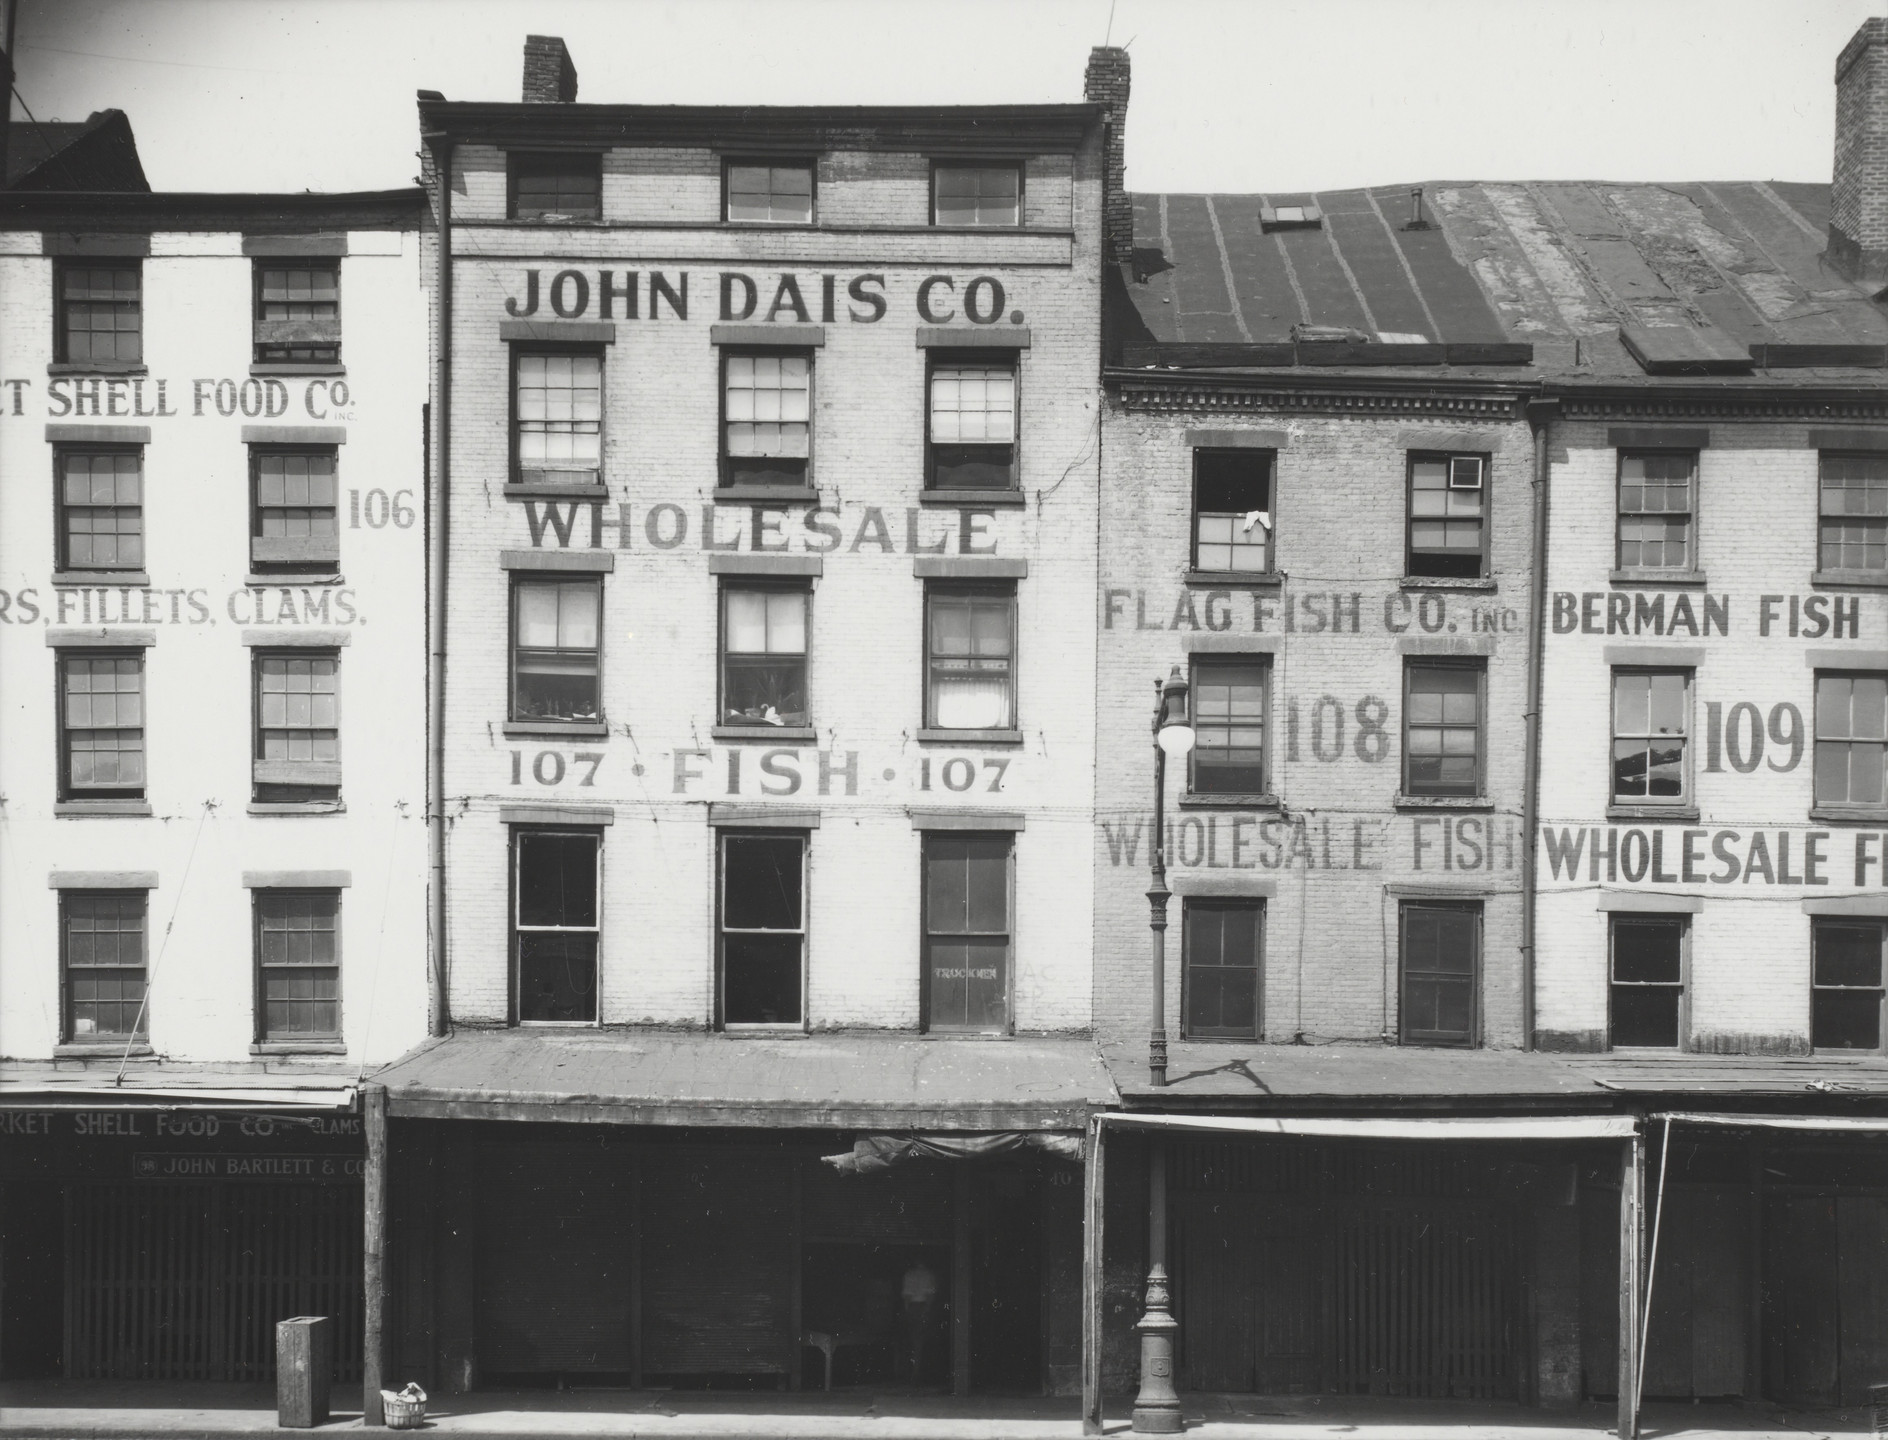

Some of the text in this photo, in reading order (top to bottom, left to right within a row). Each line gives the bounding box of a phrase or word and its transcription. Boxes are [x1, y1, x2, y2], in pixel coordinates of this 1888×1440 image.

[505, 269, 1025, 325] JOHN DAIS CO.
[47, 378, 178, 418] SHELL
[192, 378, 289, 418] FOOD
[334, 411, 359, 422] INC.
[347, 488, 416, 530] 106
[521, 500, 998, 555] WHOLESALE
[227, 588, 368, 627] CLAMS.
[1103, 589, 1233, 632] FLAG
[1252, 591, 1361, 633] FISH
[1383, 592, 1458, 634] CO.
[1552, 592, 1860, 640] BERMAN FISH
[1286, 694, 1391, 763] 108
[1702, 700, 1805, 774] 109
[509, 747, 1011, 796] 107 FISH 107
[1102, 815, 1514, 871] WHOLESALE FISH
[1542, 827, 1830, 886] WHOLESALE
[74, 1113, 141, 1136] SHELL
[156, 1114, 221, 1137] FOOD
[163, 1158, 217, 1175] JOHN
[226, 1158, 314, 1175] BARTLETT
[321, 1159, 335, 1175] &
